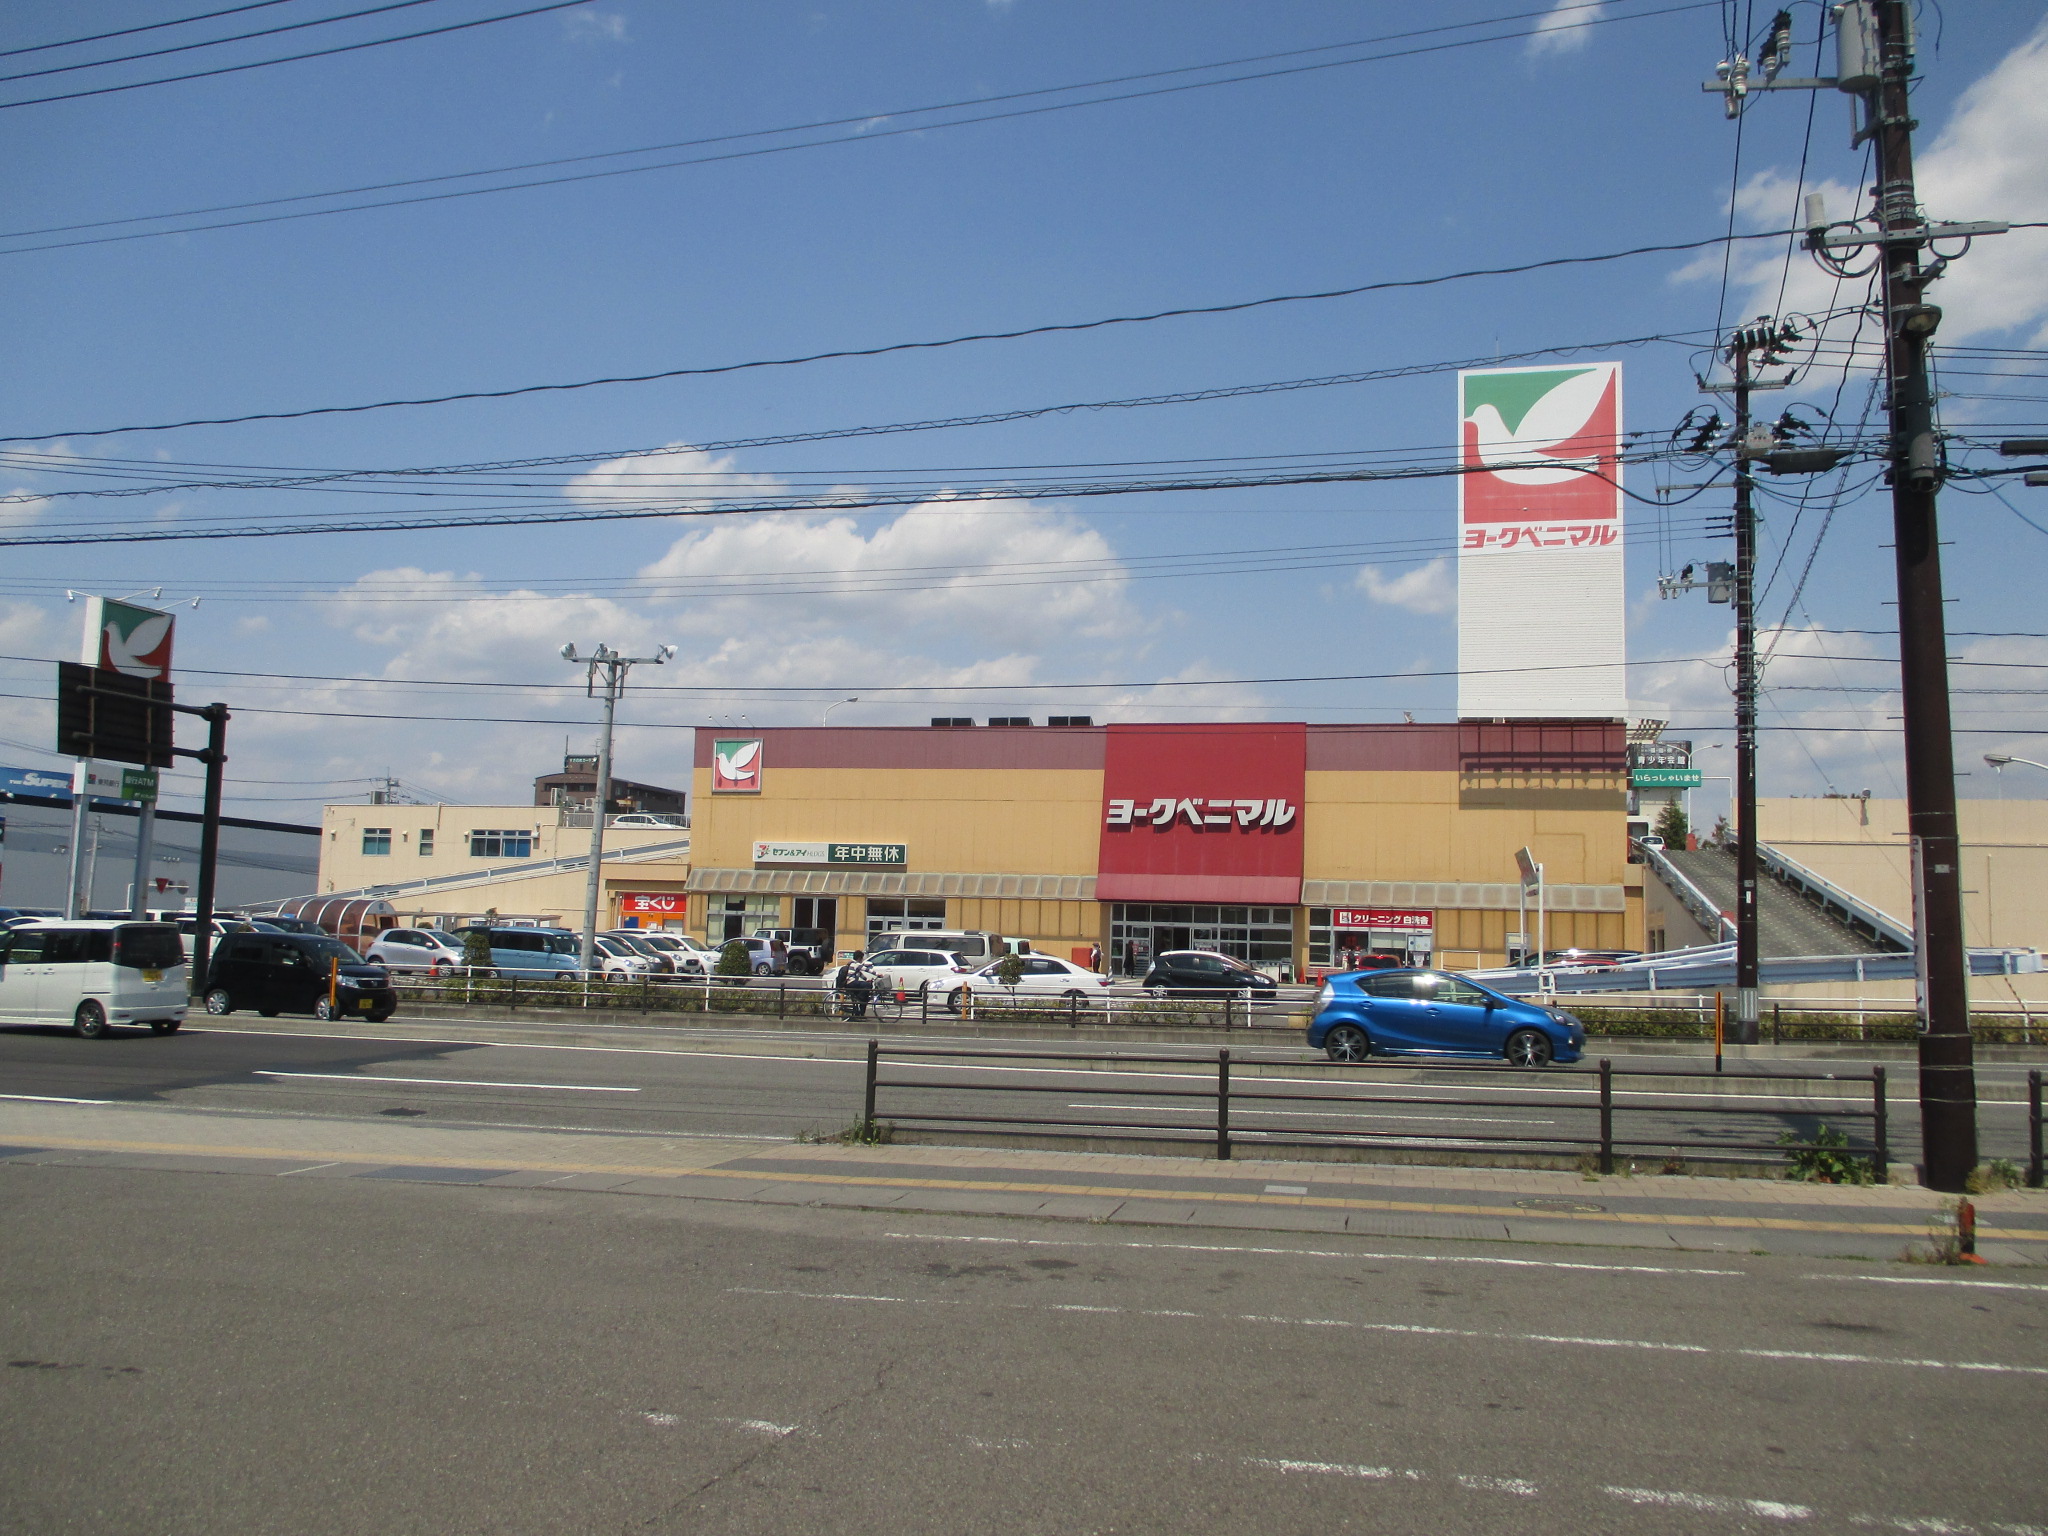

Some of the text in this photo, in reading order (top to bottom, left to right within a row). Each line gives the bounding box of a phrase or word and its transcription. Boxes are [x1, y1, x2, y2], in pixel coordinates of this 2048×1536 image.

[1463, 525, 1617, 549] ヨークベニマル
[1635, 774, 1699, 782] いらっしゃいませ
[1106, 798, 1295, 826] ヨークベニマル
[834, 846, 900, 862] 年中無休
[634, 895, 675, 910] 宝くじ
[1354, 915, 1402, 923] クリーニング
